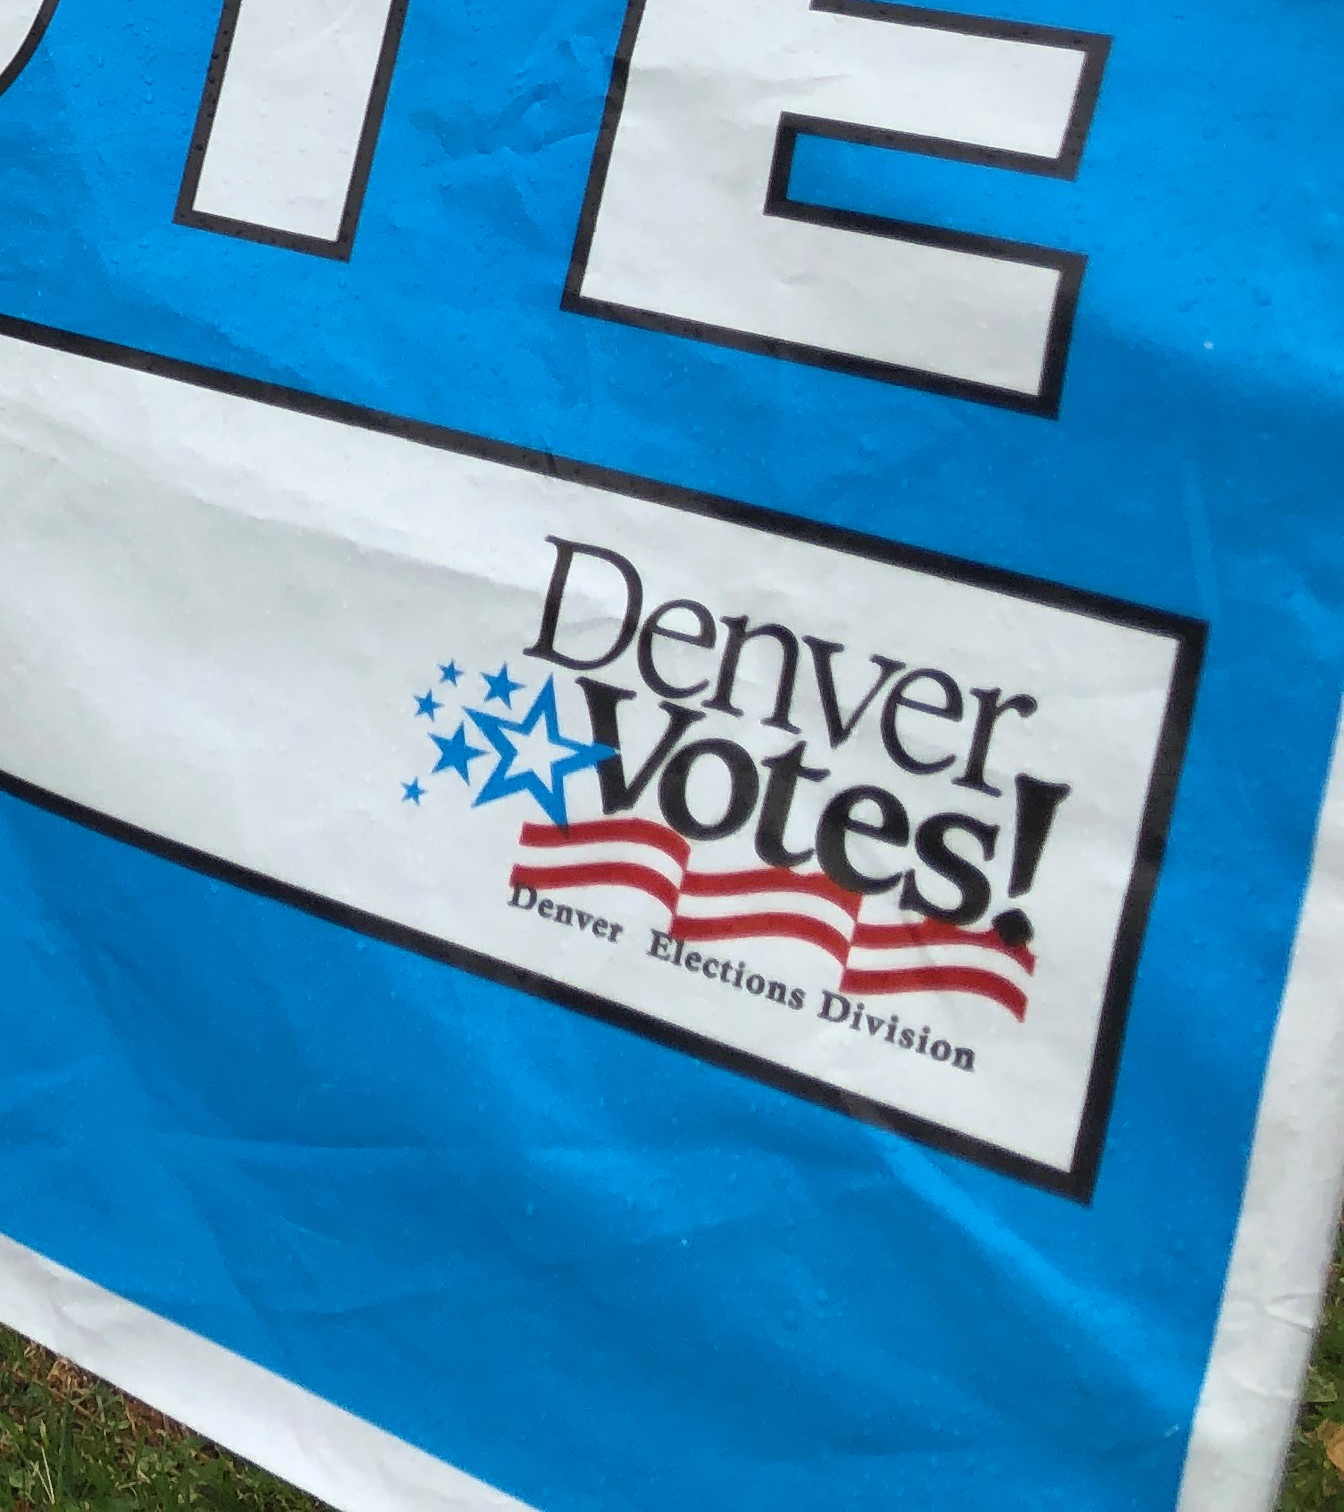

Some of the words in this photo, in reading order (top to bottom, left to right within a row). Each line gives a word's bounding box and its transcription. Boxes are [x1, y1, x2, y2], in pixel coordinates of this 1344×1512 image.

[523, 535, 1038, 797] Denver
[576, 677, 1071, 947] Votes!
[507, 882, 623, 944] Denver
[646, 929, 807, 1010] Elections
[817, 991, 978, 1073] Division
